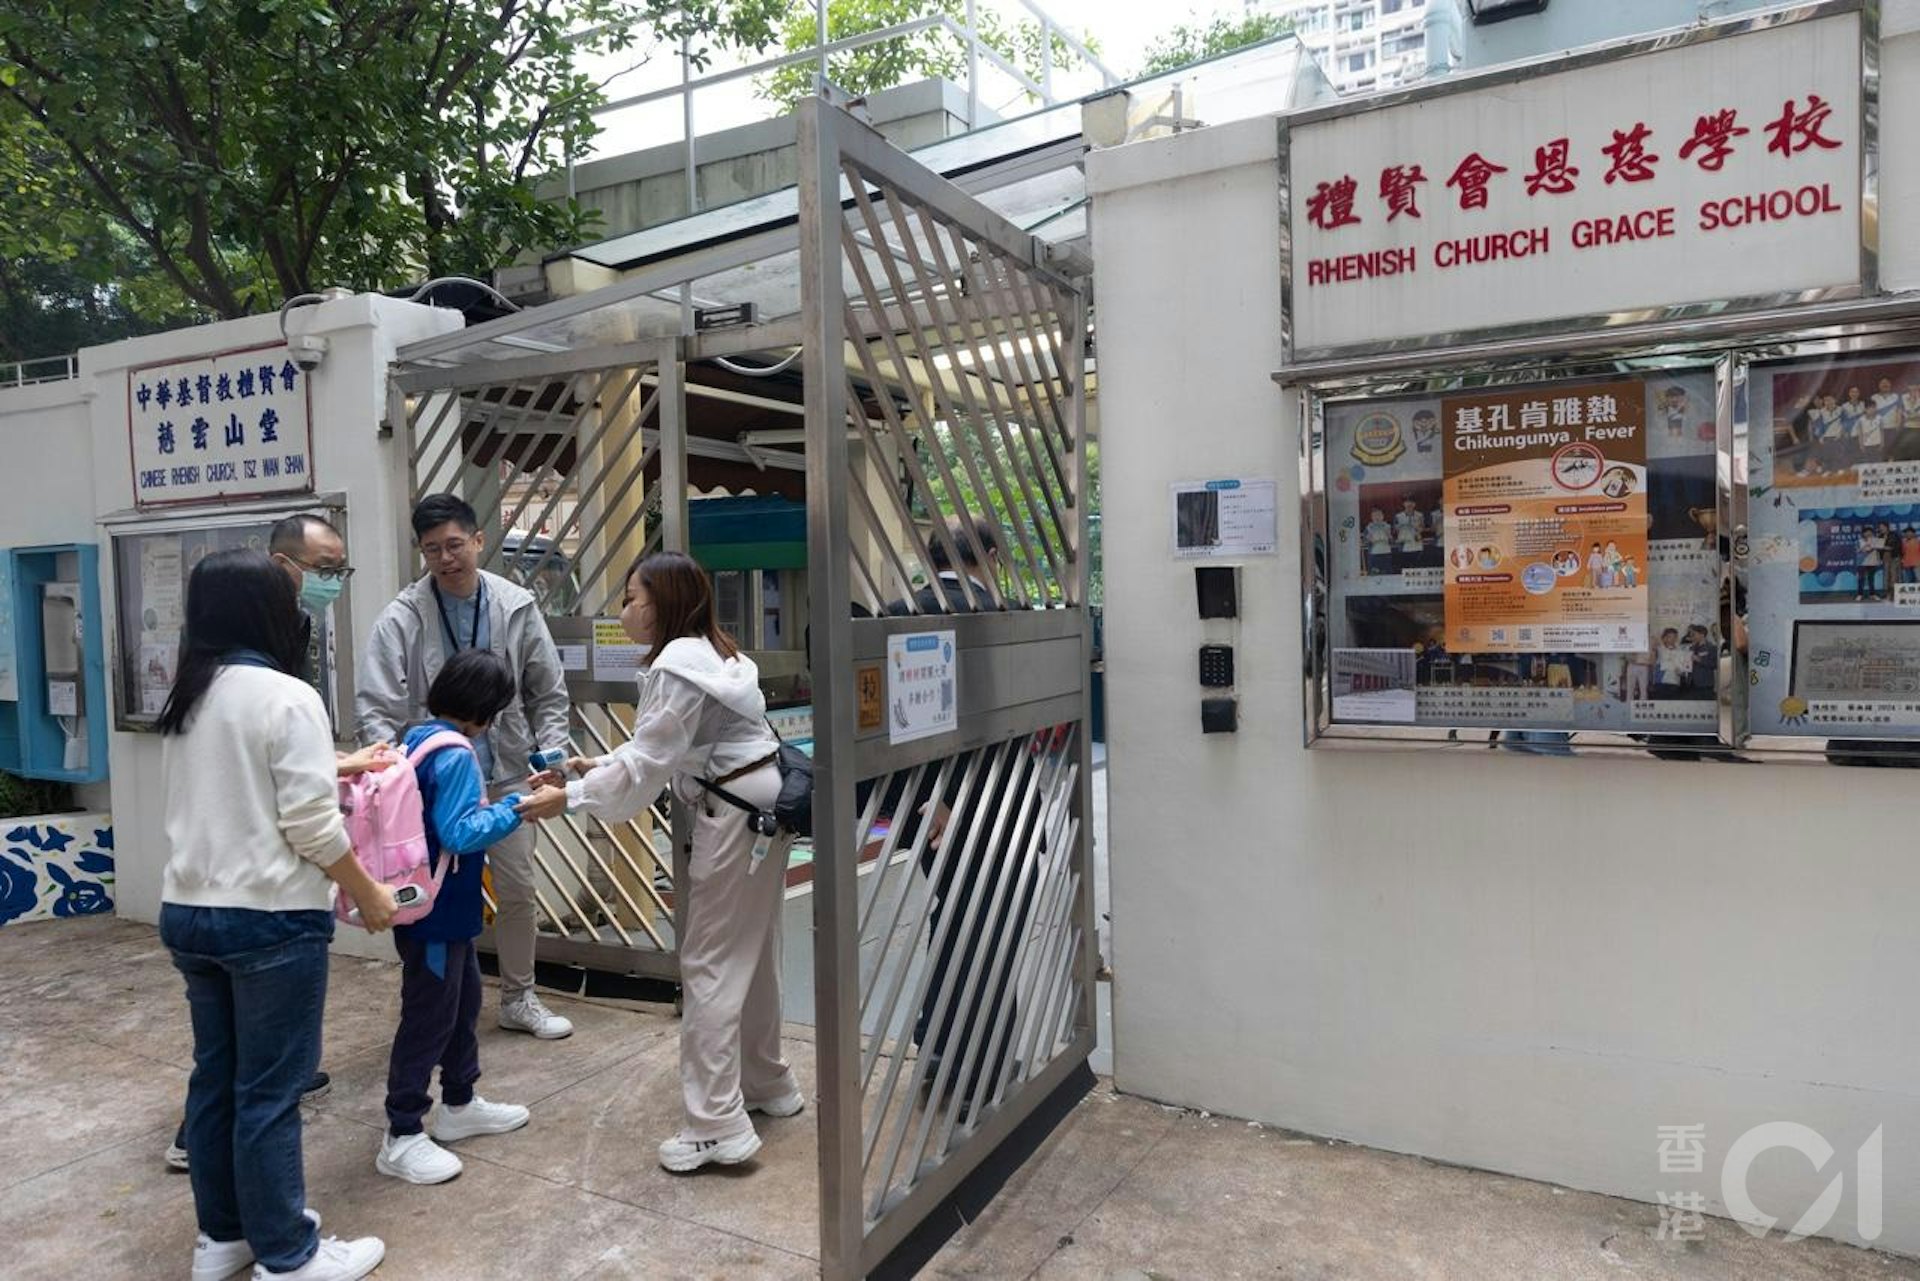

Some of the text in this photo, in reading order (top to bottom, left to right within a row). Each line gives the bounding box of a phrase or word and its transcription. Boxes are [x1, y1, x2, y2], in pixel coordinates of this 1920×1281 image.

[1305, 95, 1843, 232] 禮賢會恩慈學校
[1308, 185, 1841, 286] RHENISH CHURCH GRACE SCHOOL
[136, 358, 300, 412] 中華基督教禮賢會
[157, 408, 280, 454] 慈雲山堂
[1454, 423, 1637, 452] Chikungunya Fever
[1455, 395, 1619, 435] 基孔肯雅熱
[172, 465, 200, 486] RHENISH
[243, 459, 257, 479] TSZ
[262, 457, 280, 477] WAN
[284, 454, 304, 474] SHAN
